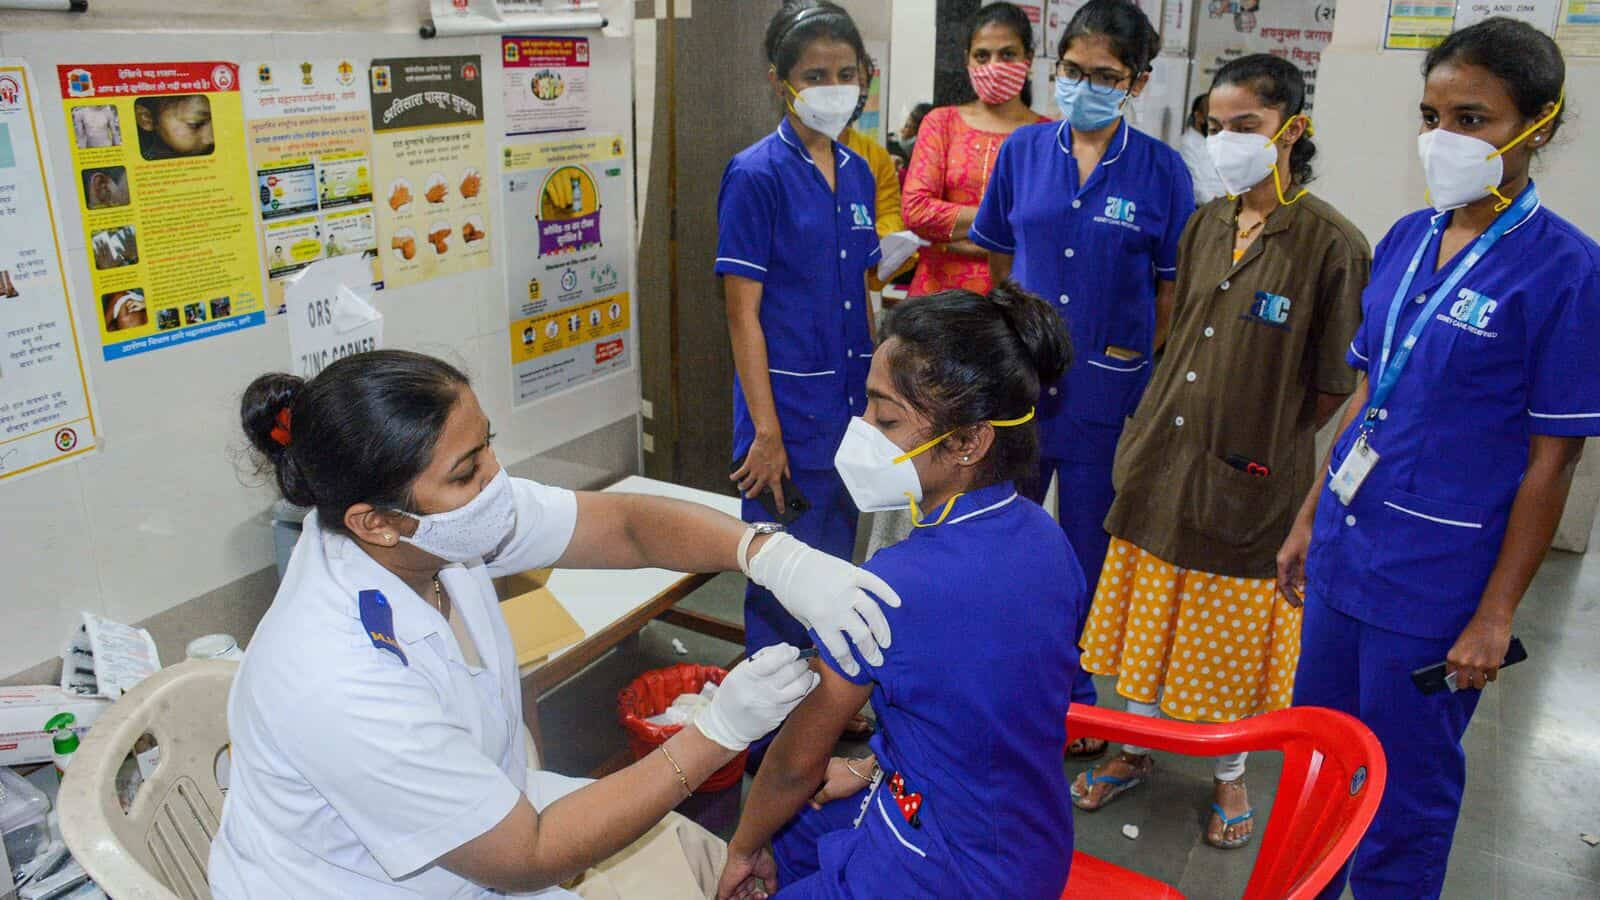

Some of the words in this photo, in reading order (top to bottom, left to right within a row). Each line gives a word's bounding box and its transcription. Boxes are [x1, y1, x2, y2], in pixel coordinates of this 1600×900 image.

[424, 91, 452, 110] पासून
[451, 94, 477, 118] सुरक्षा
[308, 299, 332, 329] ORS
[301, 349, 328, 380] ZINC
